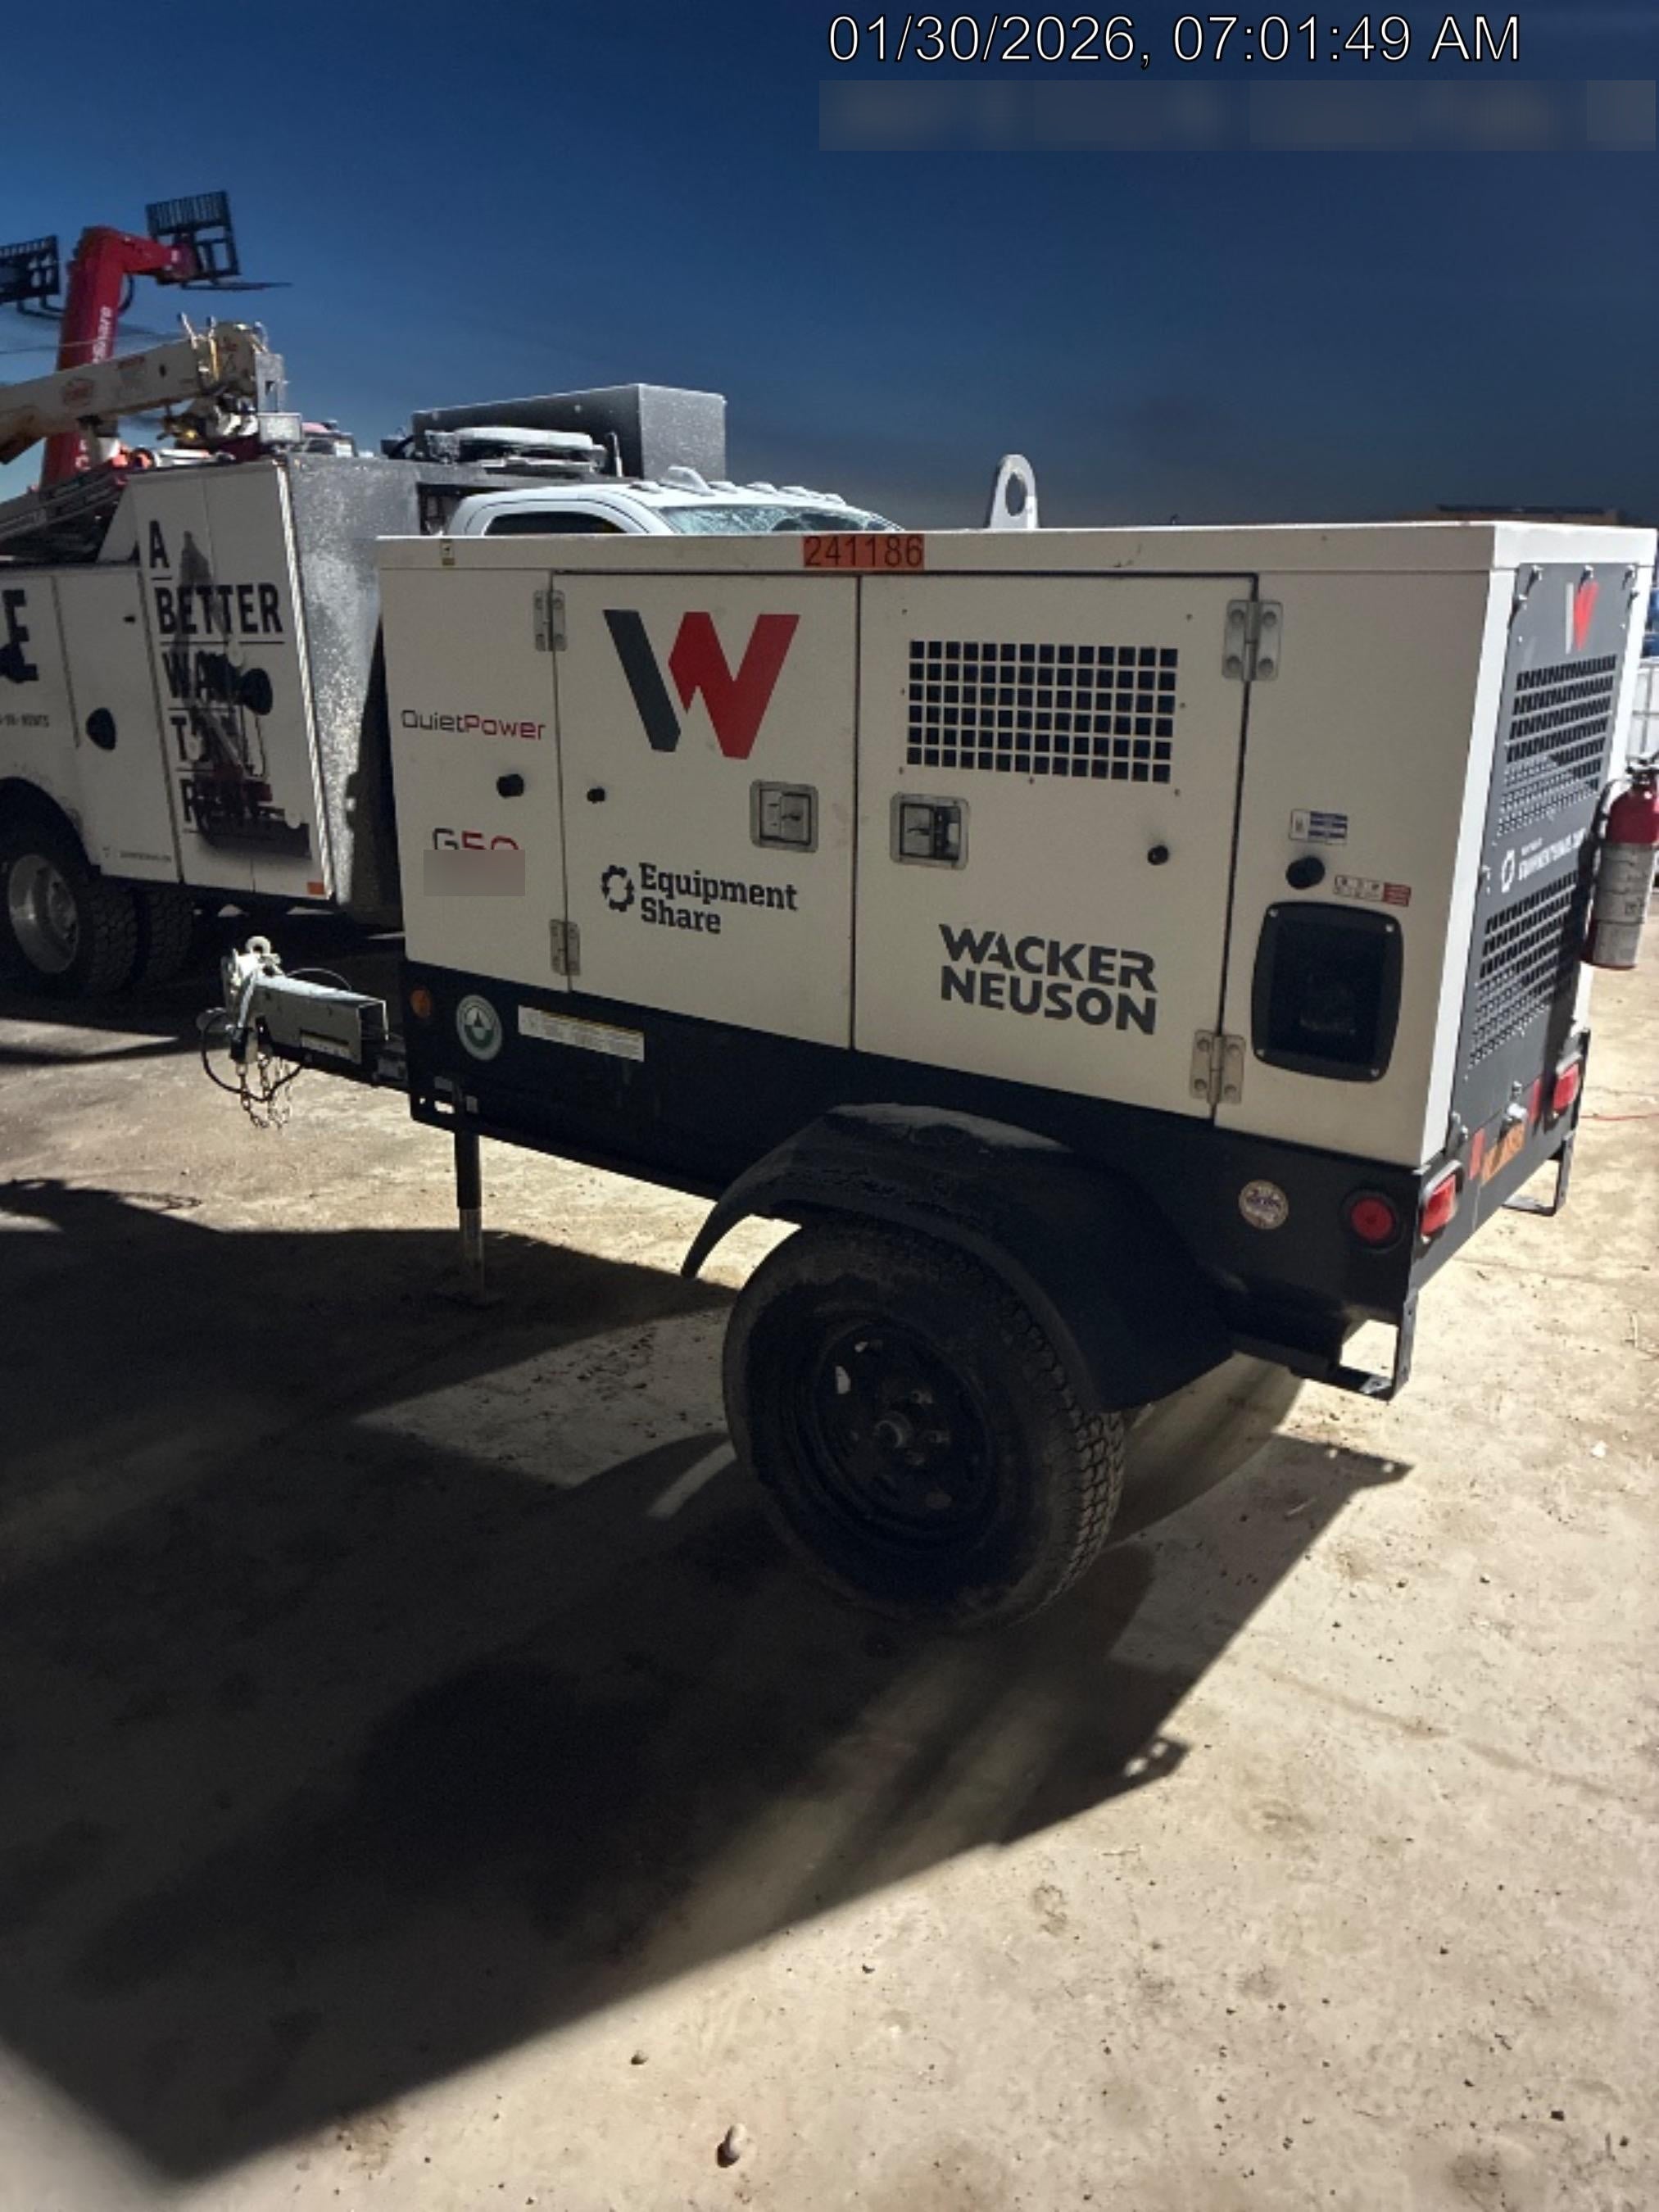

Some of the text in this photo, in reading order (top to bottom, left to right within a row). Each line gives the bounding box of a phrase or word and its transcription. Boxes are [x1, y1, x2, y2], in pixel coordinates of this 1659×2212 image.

[149, 519, 170, 569] A
[800, 535, 923, 567] 241186
[154, 582, 283, 635] BETTER
[401, 709, 546, 740] QuietPower
[639, 862, 798, 911] Equipment
[641, 896, 721, 934] Share
[939, 923, 1158, 993] WACKER
[941, 965, 1156, 1035] NEUSON
